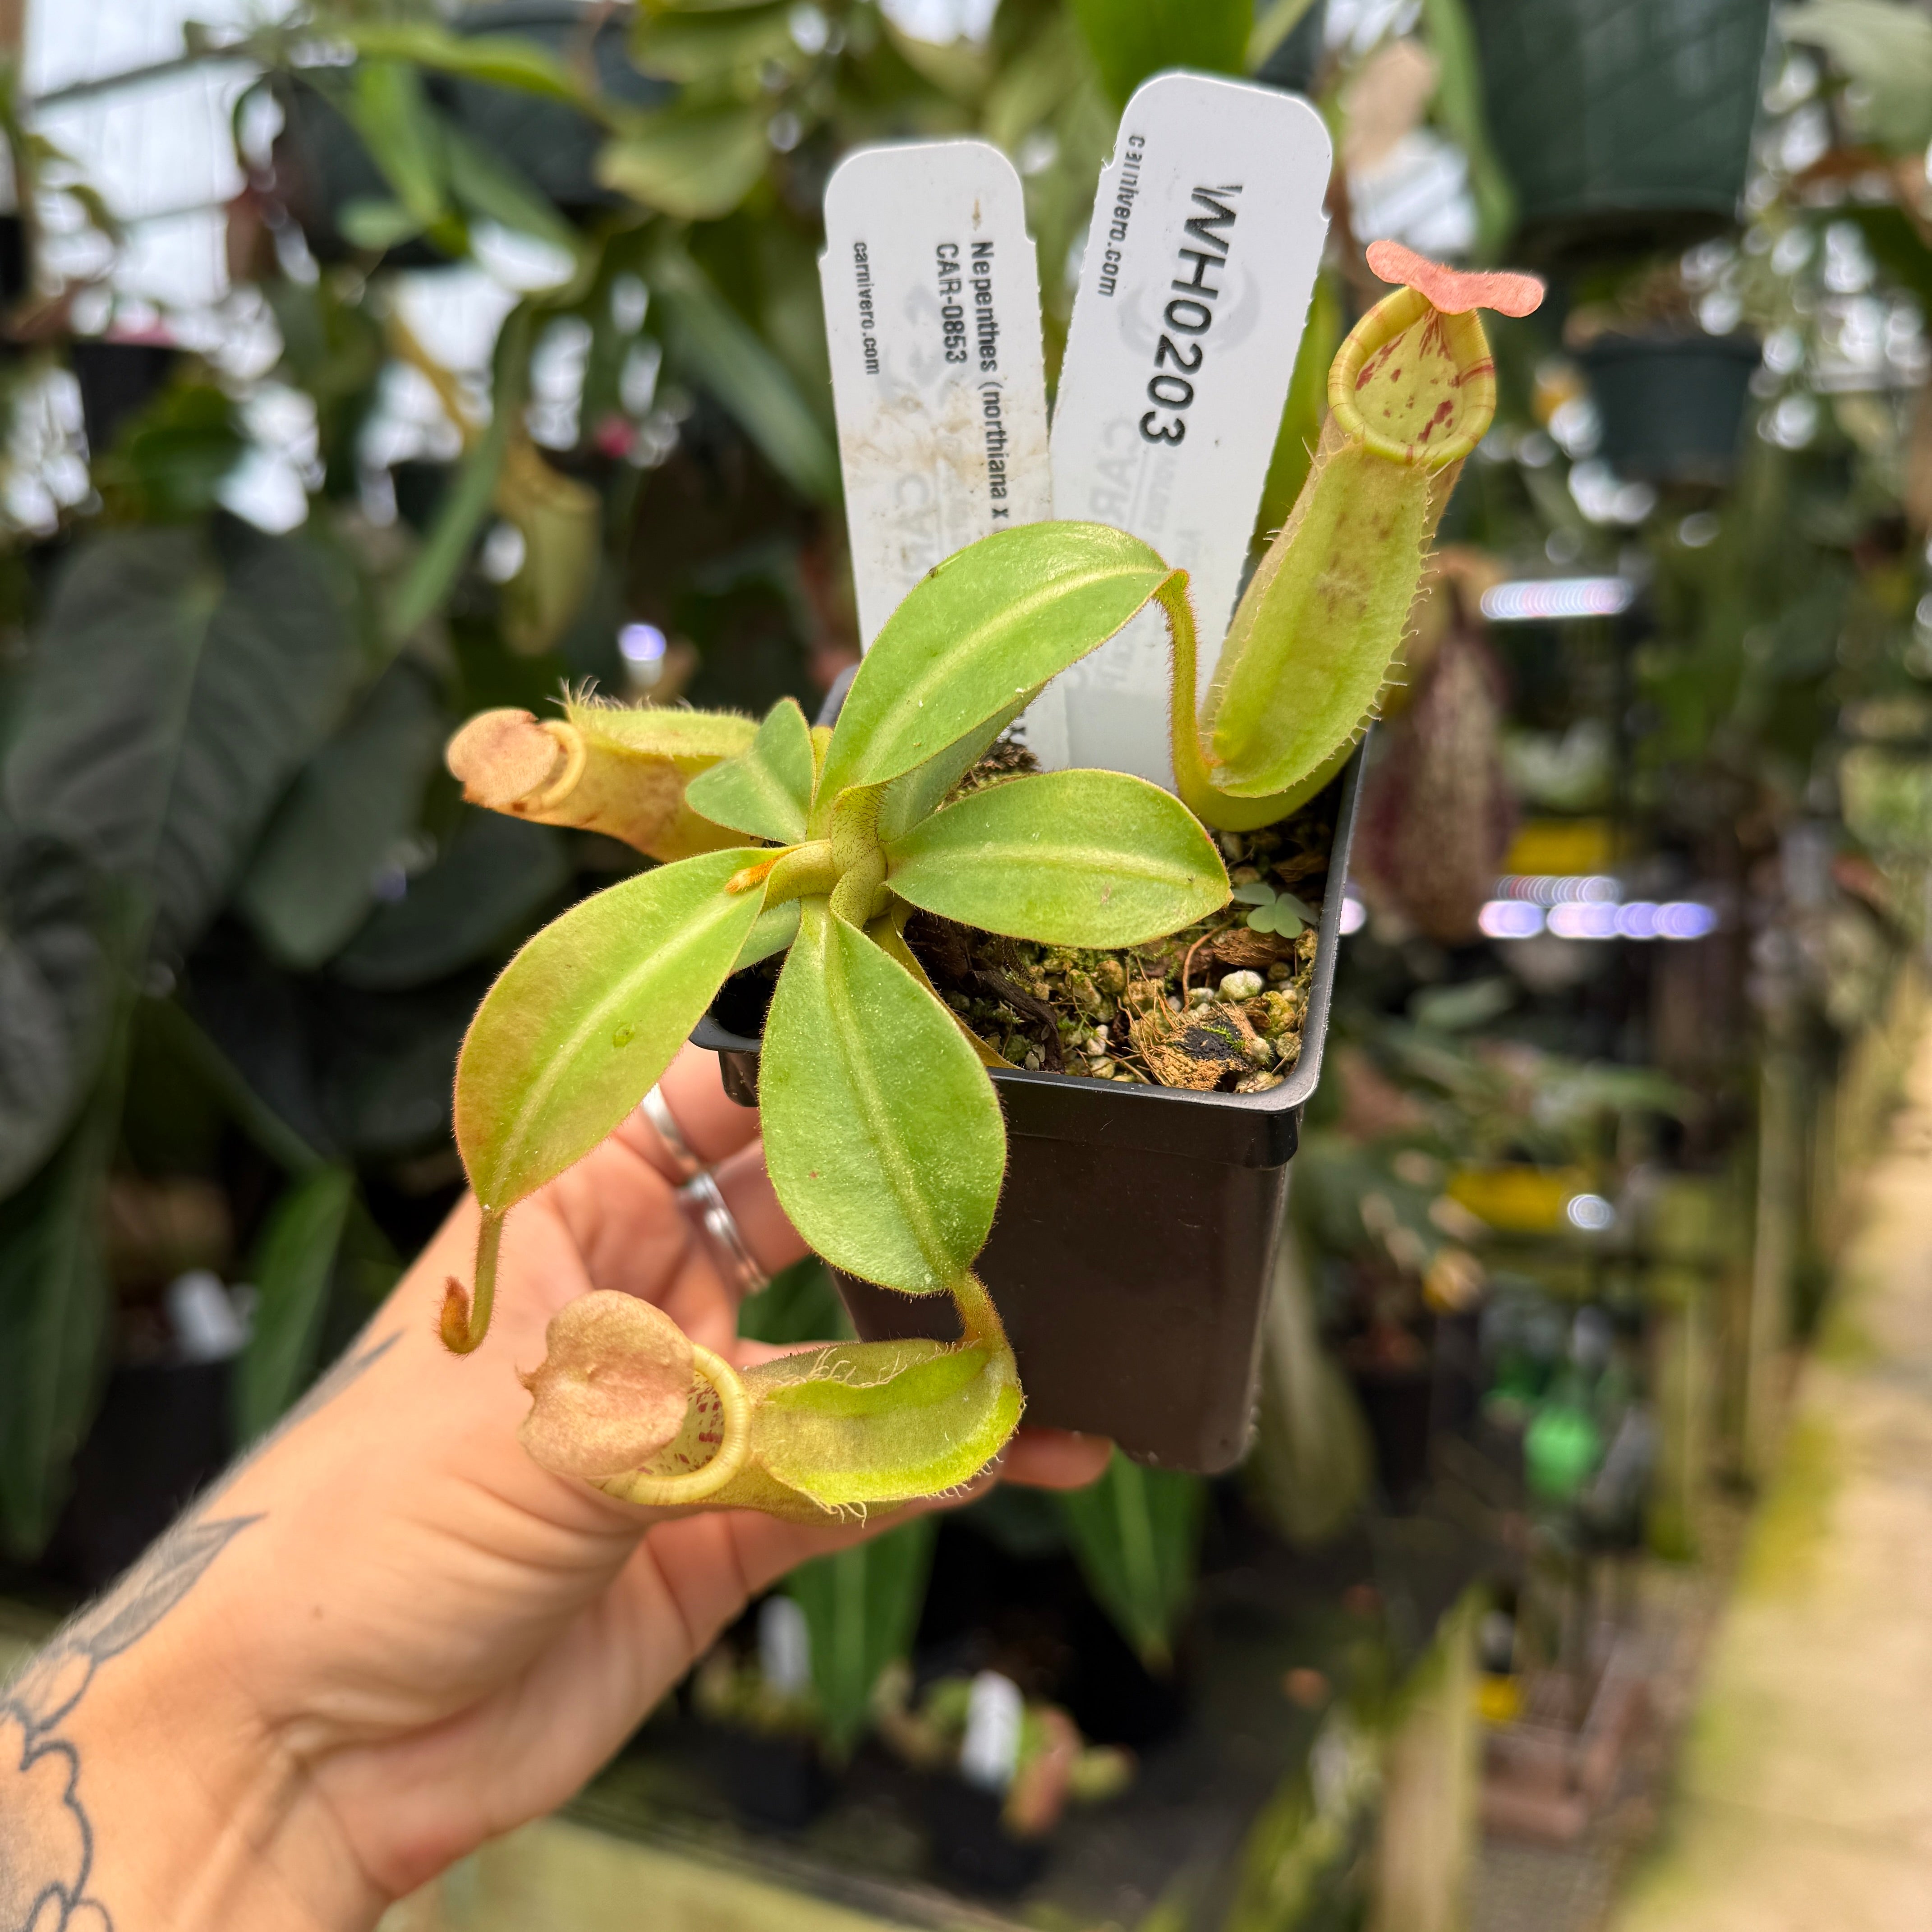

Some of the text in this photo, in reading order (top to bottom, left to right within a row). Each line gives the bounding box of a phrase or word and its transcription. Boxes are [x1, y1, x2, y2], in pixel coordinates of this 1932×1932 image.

[1098, 136, 1145, 297] carnivero.com
[854, 242, 880, 375] carnivero.com
[936, 243, 967, 364] CAR-0853
[969, 242, 1009, 519] Nepenthes (northiana x
[1139, 185, 1243, 447] WH0203
